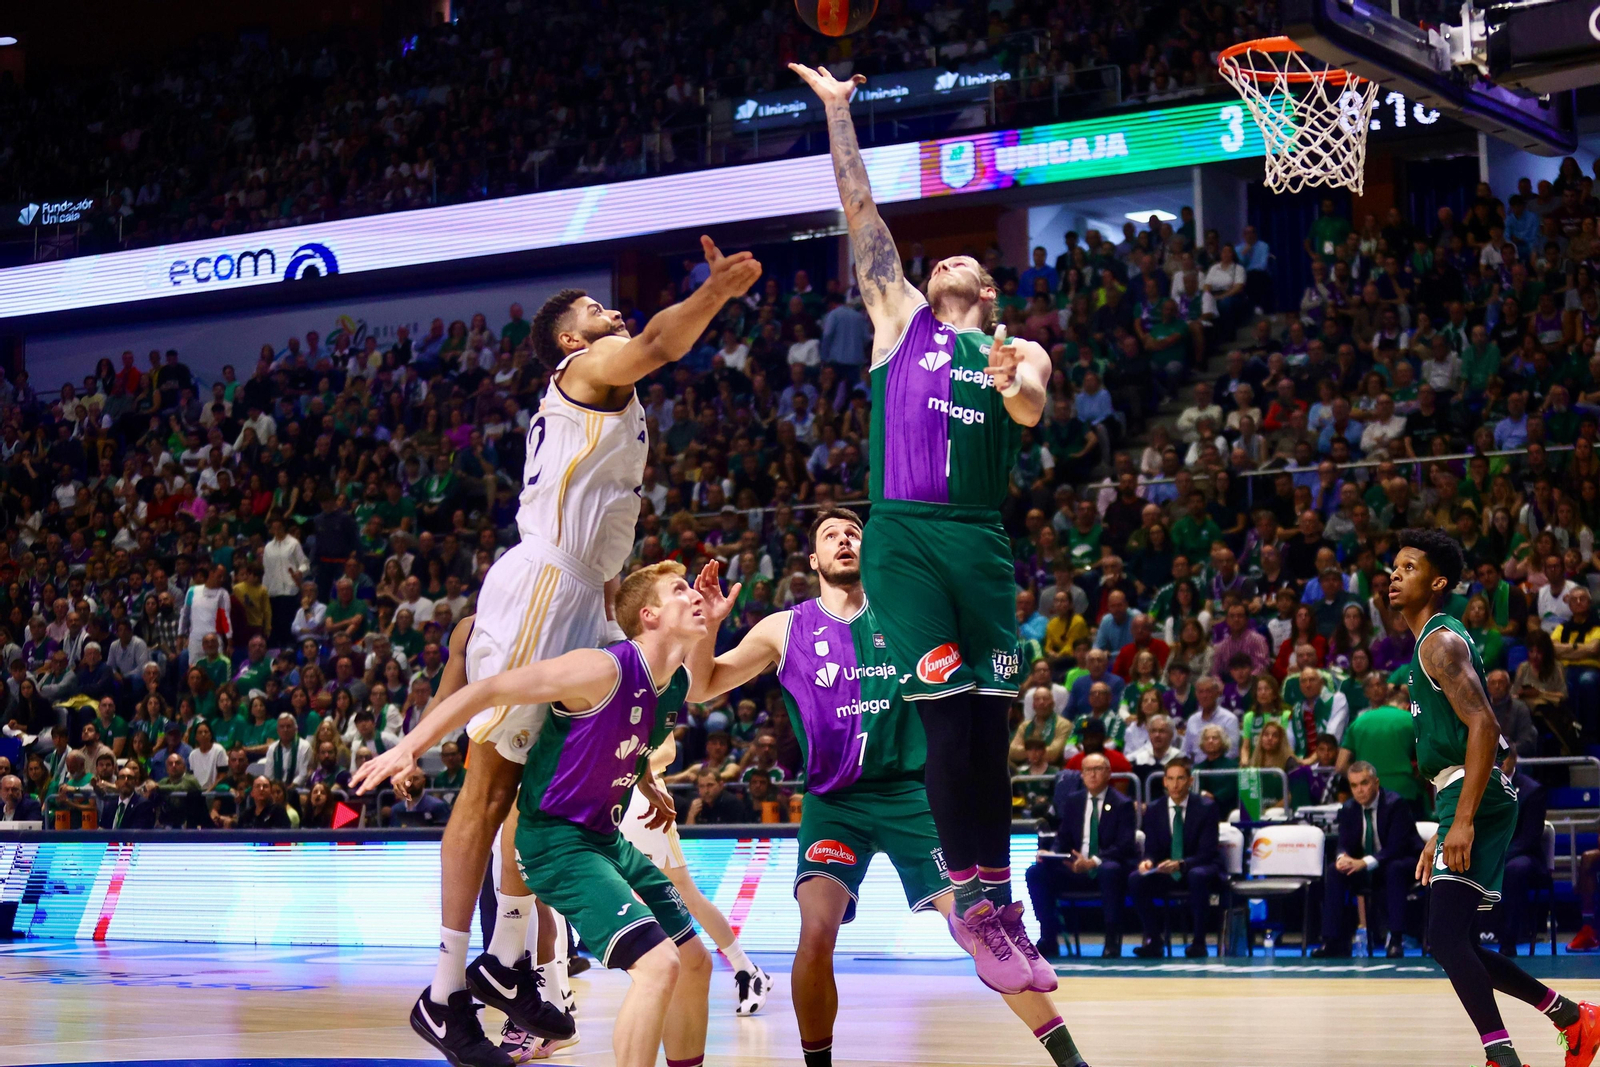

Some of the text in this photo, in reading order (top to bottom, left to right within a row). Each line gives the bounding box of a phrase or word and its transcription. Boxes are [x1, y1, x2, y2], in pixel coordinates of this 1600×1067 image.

[994, 105, 1244, 172] UNICAJA 3
[856, 732, 869, 767] 7
